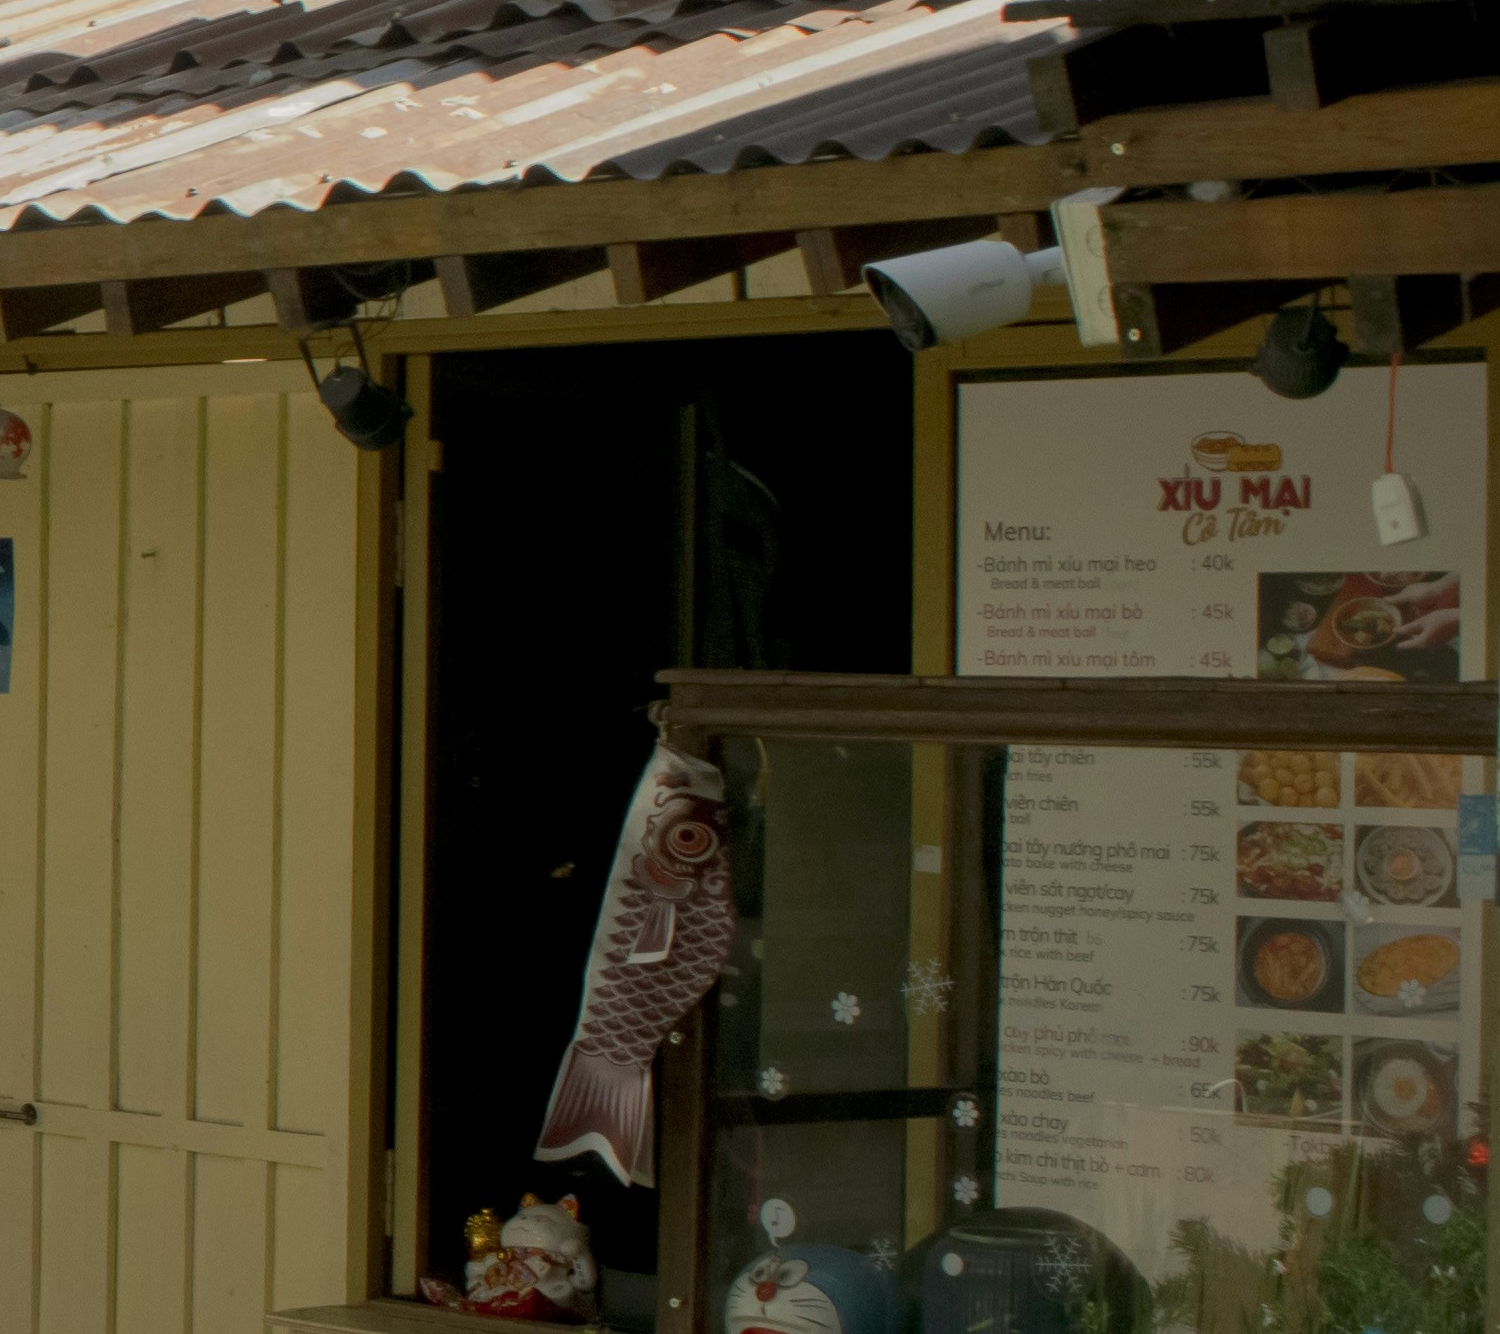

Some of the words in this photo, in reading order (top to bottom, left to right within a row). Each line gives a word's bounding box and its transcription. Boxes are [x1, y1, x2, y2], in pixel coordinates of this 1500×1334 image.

[984, 521, 1051, 541] Menu:
[1124, 555, 1157, 572] heo
[990, 577, 1028, 589] Bread
[1031, 578, 1040, 589] &
[1043, 578, 1075, 589] meat
[1078, 577, 1101, 589] ball
[987, 626, 1023, 638] Bread
[1039, 627, 1070, 638] meat
